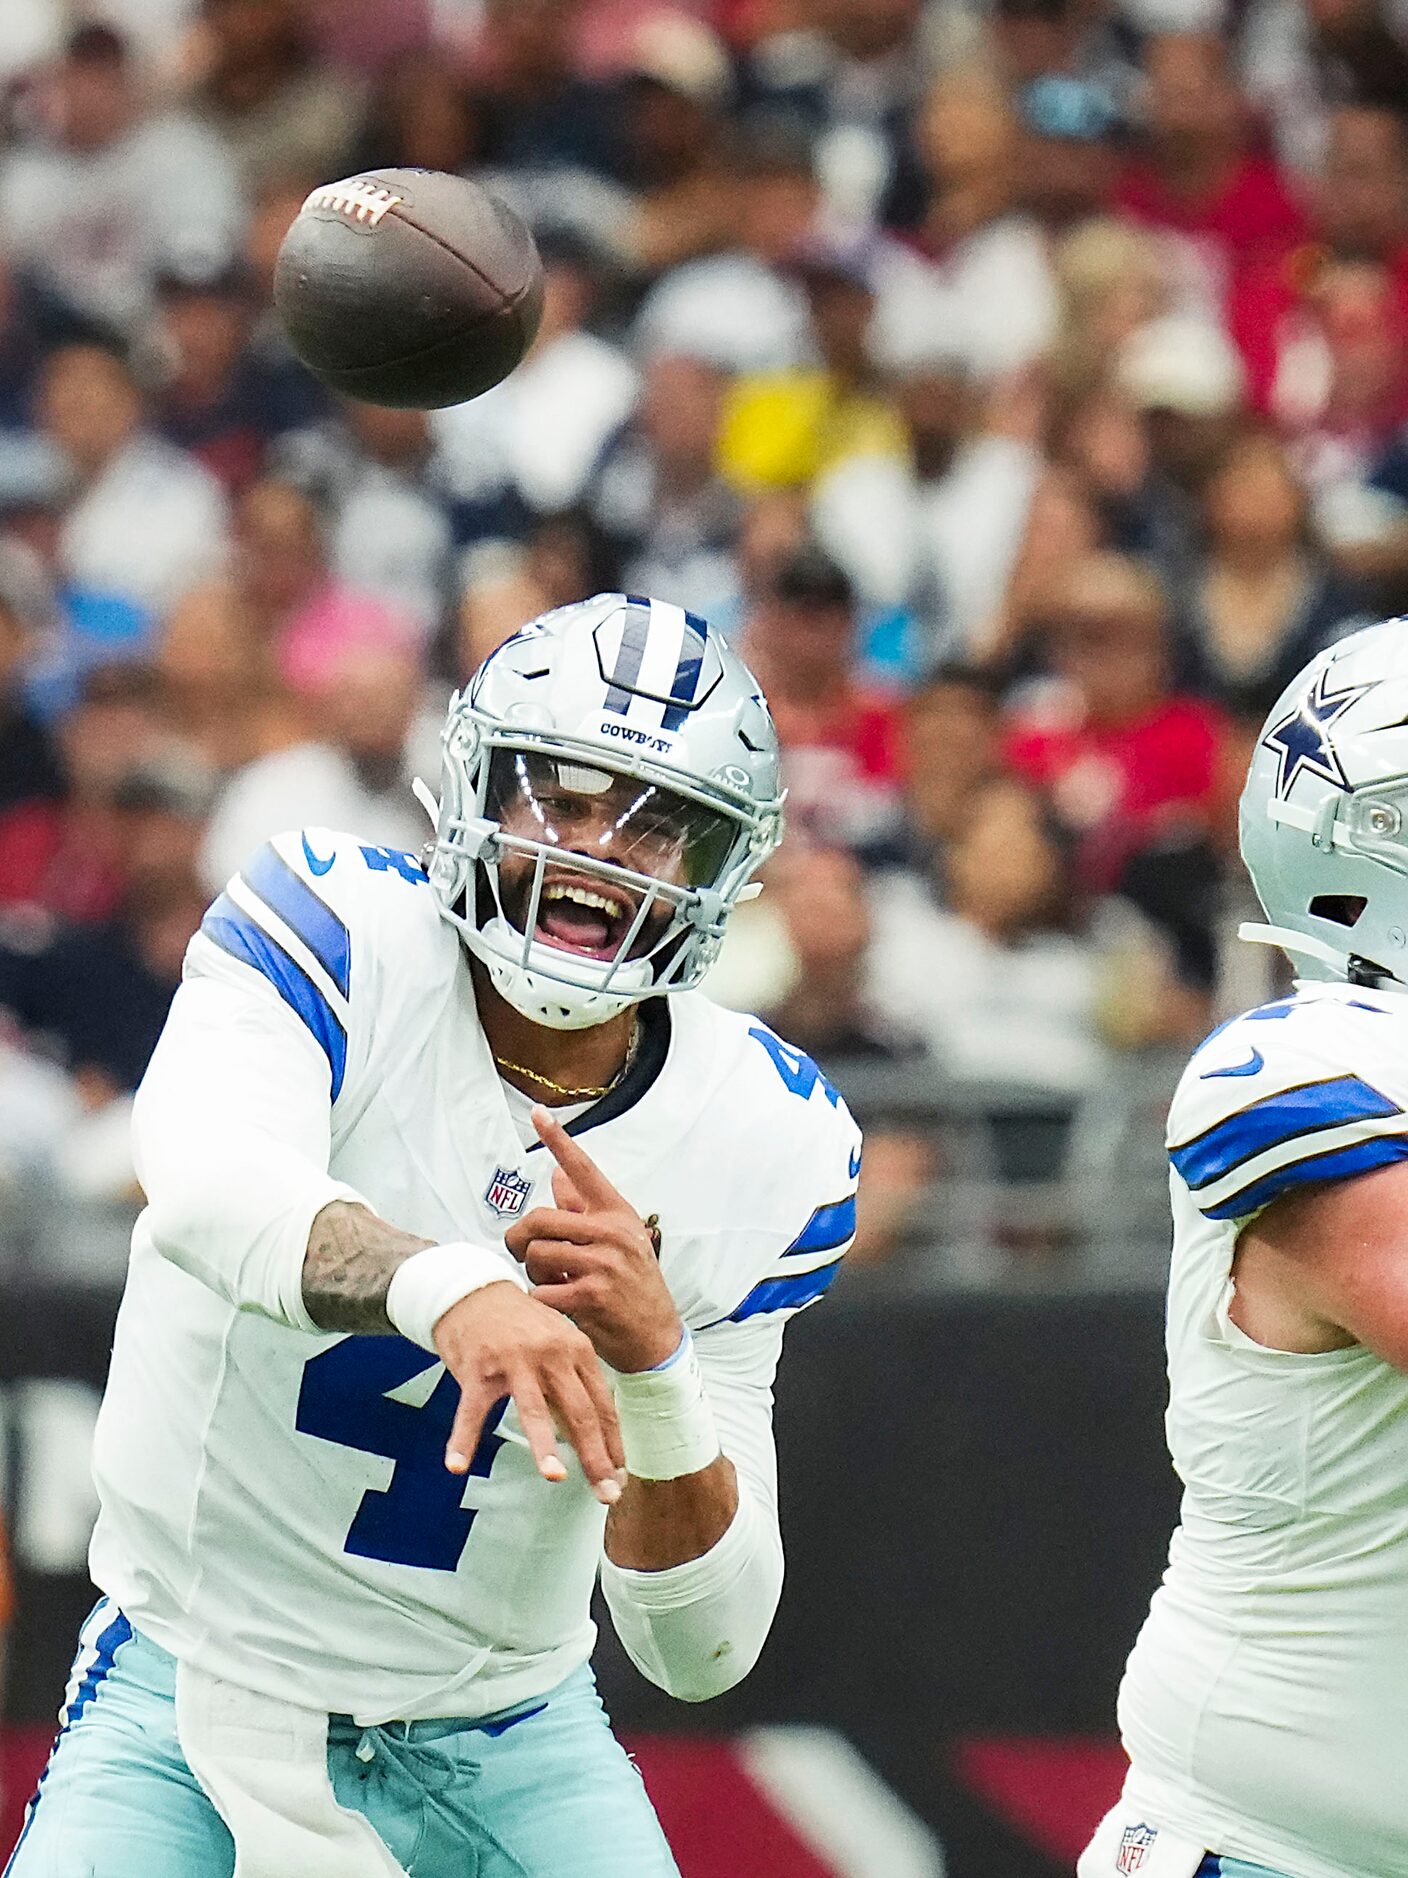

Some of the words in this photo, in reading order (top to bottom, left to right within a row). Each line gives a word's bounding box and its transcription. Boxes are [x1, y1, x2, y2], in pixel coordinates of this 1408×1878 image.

[489, 1184, 519, 1211] NFL
[295, 1334, 512, 1573] 4
[1119, 1845, 1146, 1873] NFL
